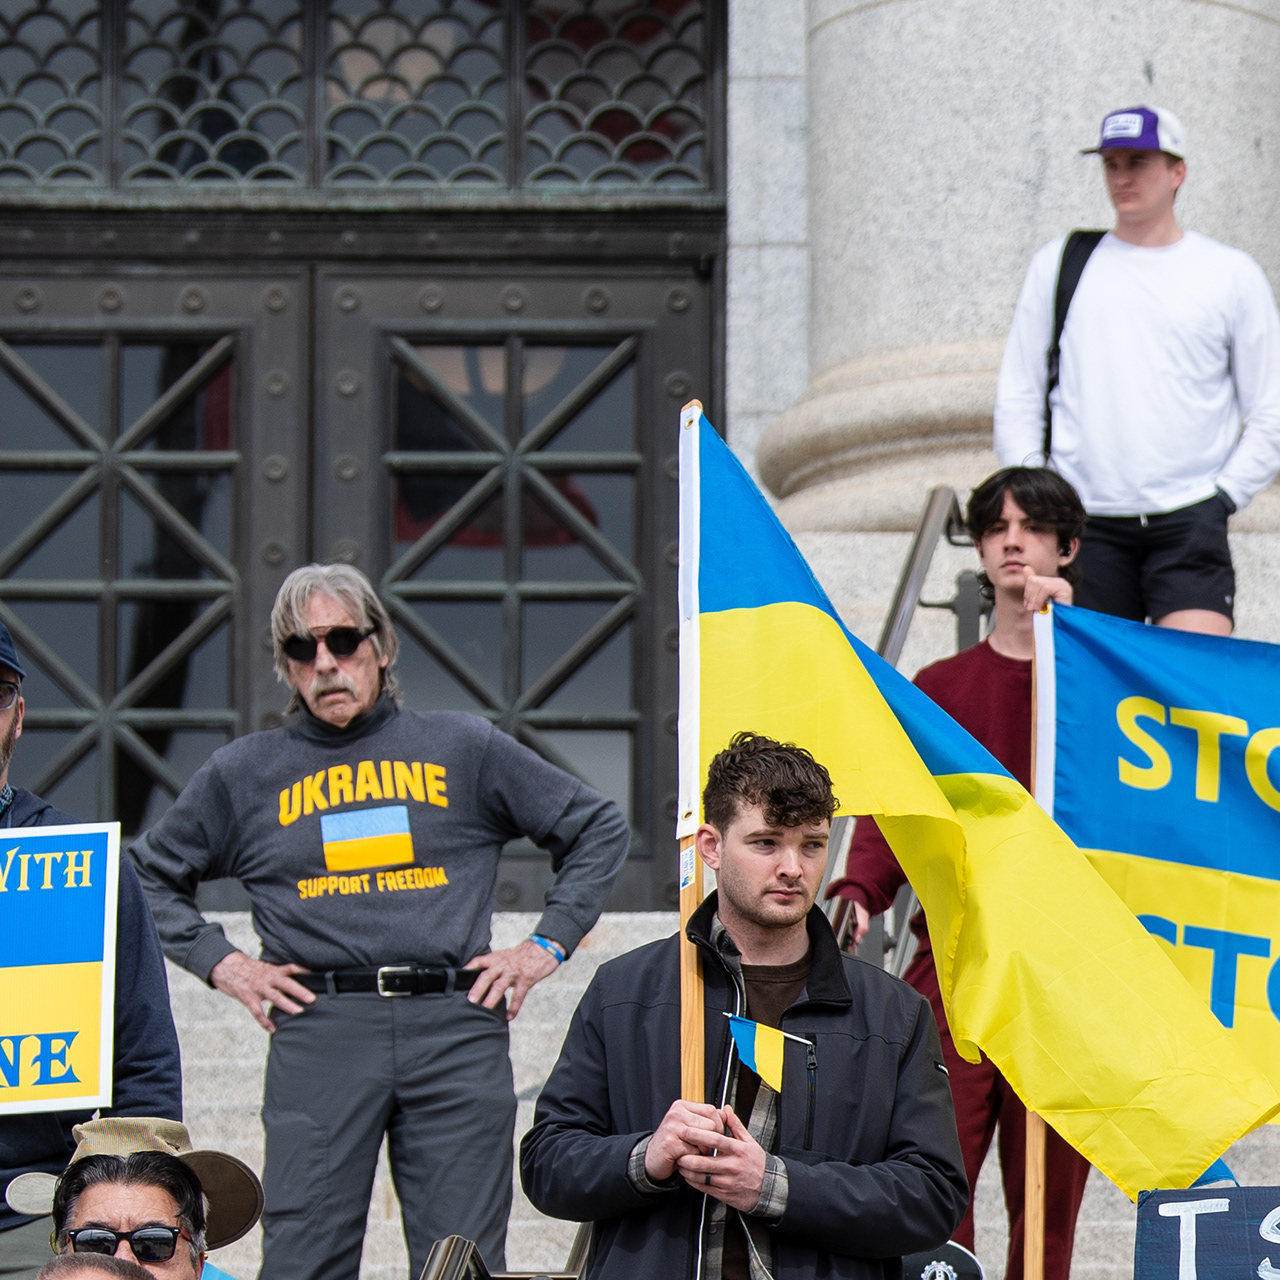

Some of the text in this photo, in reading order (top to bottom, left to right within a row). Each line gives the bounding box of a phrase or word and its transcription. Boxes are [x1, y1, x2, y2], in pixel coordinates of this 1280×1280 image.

[278, 760, 449, 827] UKRAINE
[298, 866, 450, 900] SUPPORT FREEDOM
